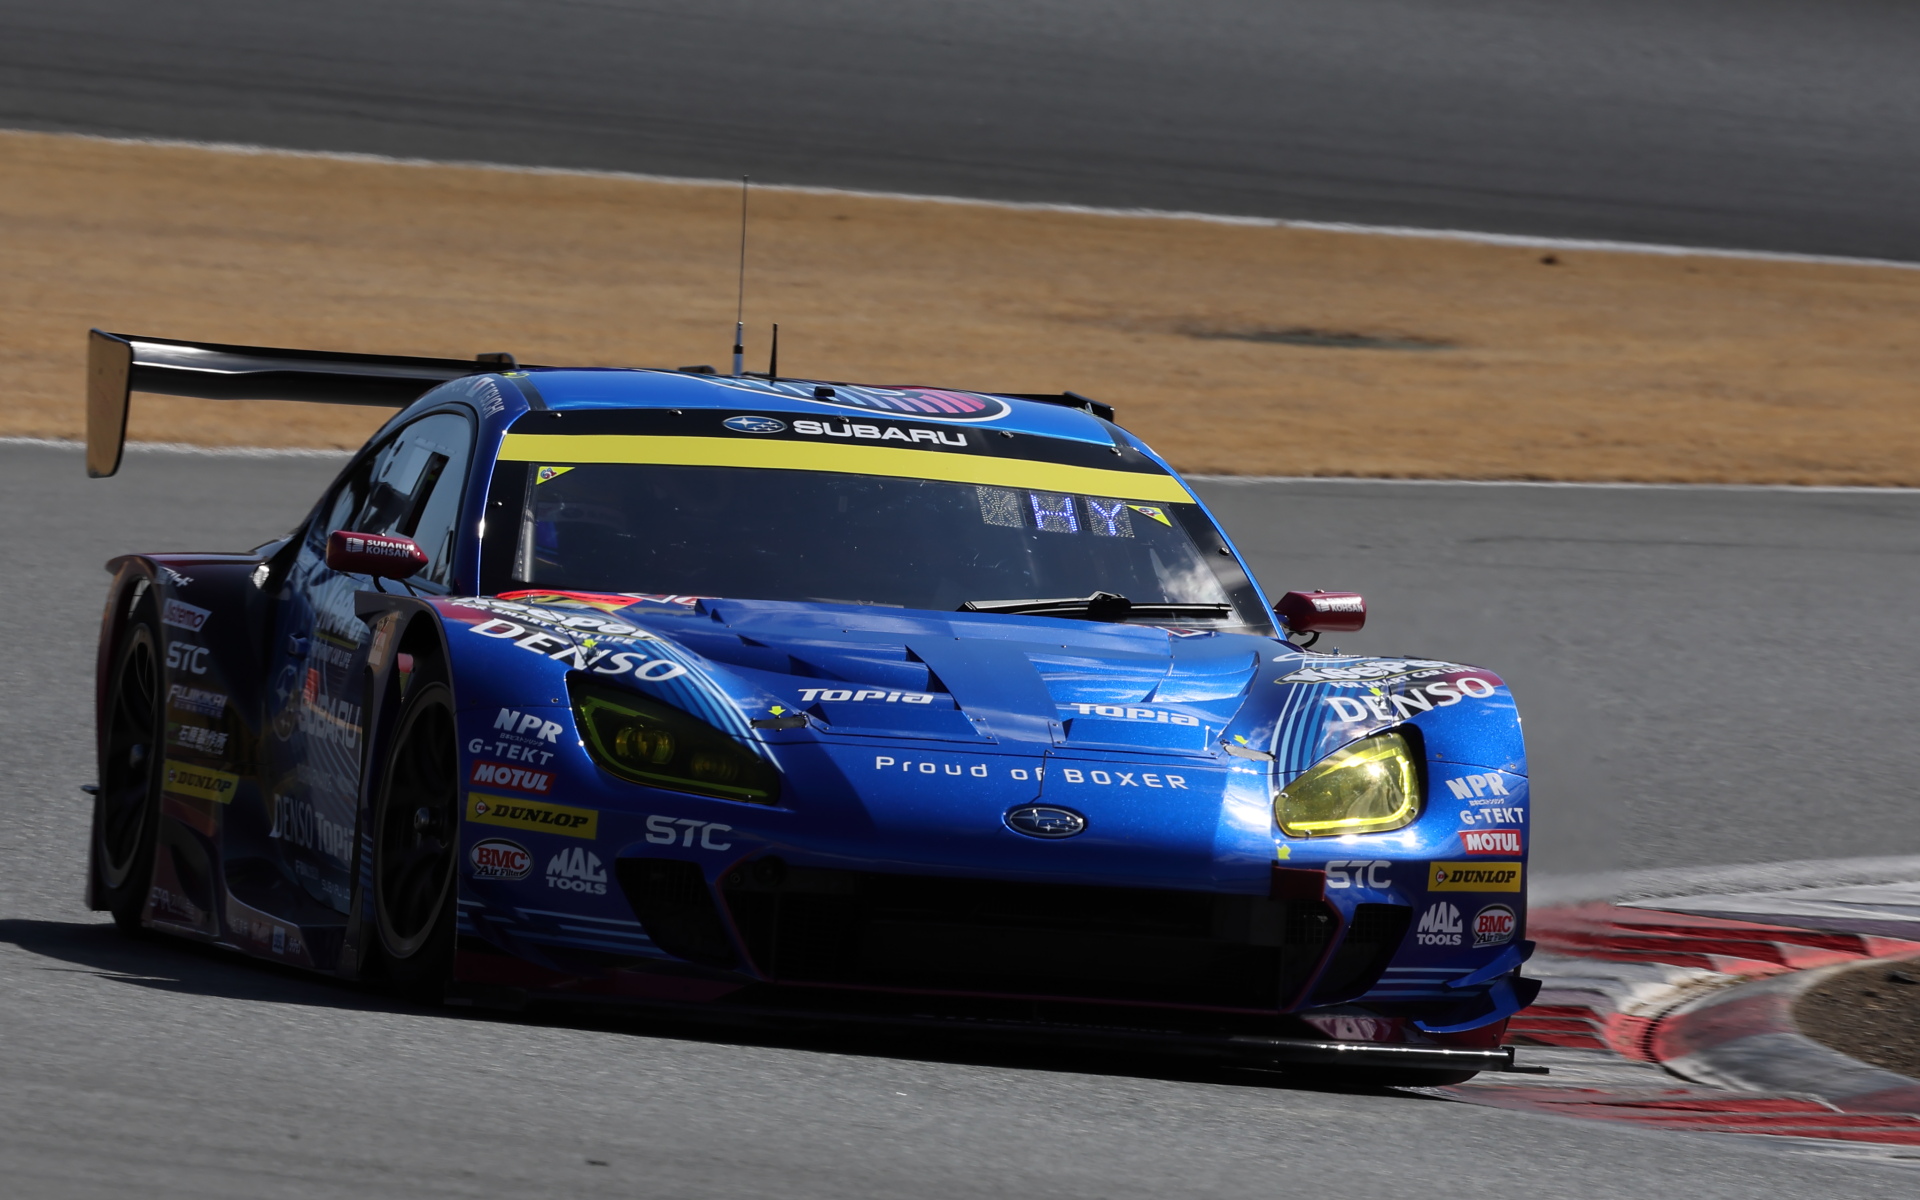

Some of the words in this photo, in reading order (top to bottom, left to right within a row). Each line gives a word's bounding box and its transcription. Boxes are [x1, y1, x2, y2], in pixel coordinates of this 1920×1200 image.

[792, 420, 967, 447] SUBARU
[366, 546, 409, 558] KOHSAN
[367, 539, 410, 551] SUBARU
[1331, 604, 1364, 613] KOHSAN
[491, 608, 552, 627] SMART
[594, 634, 636, 645] LIFE
[165, 641, 210, 675] STC
[468, 618, 688, 682] DENSO
[1325, 677, 1495, 723] DENSO
[493, 708, 563, 744] NPR
[468, 738, 554, 765] G-TEKT
[177, 771, 232, 792] DUNLOP
[474, 764, 548, 791] MOTUL
[875, 756, 988, 778] Proud
[1010, 767, 1045, 781] of
[1063, 768, 1188, 790] BOXER
[1445, 772, 1510, 800] NPR
[269, 793, 314, 850] DENSO
[491, 804, 589, 828] DUNLOP
[1460, 807, 1524, 825] G-TEKT
[645, 815, 732, 850] STC
[1466, 834, 1520, 851] MOTUL
[477, 847, 526, 870] BMC
[478, 865, 500, 877] Air
[500, 868, 521, 878] Filter
[546, 847, 607, 882] MAC
[546, 876, 607, 895] TOOLS
[1325, 860, 1392, 889] STC
[1450, 870, 1516, 884] DUNLOP
[1417, 902, 1463, 933] MAC
[1478, 915, 1512, 932] BMC
[1416, 934, 1462, 946] TOOLS
[1476, 932, 1493, 944] Air
